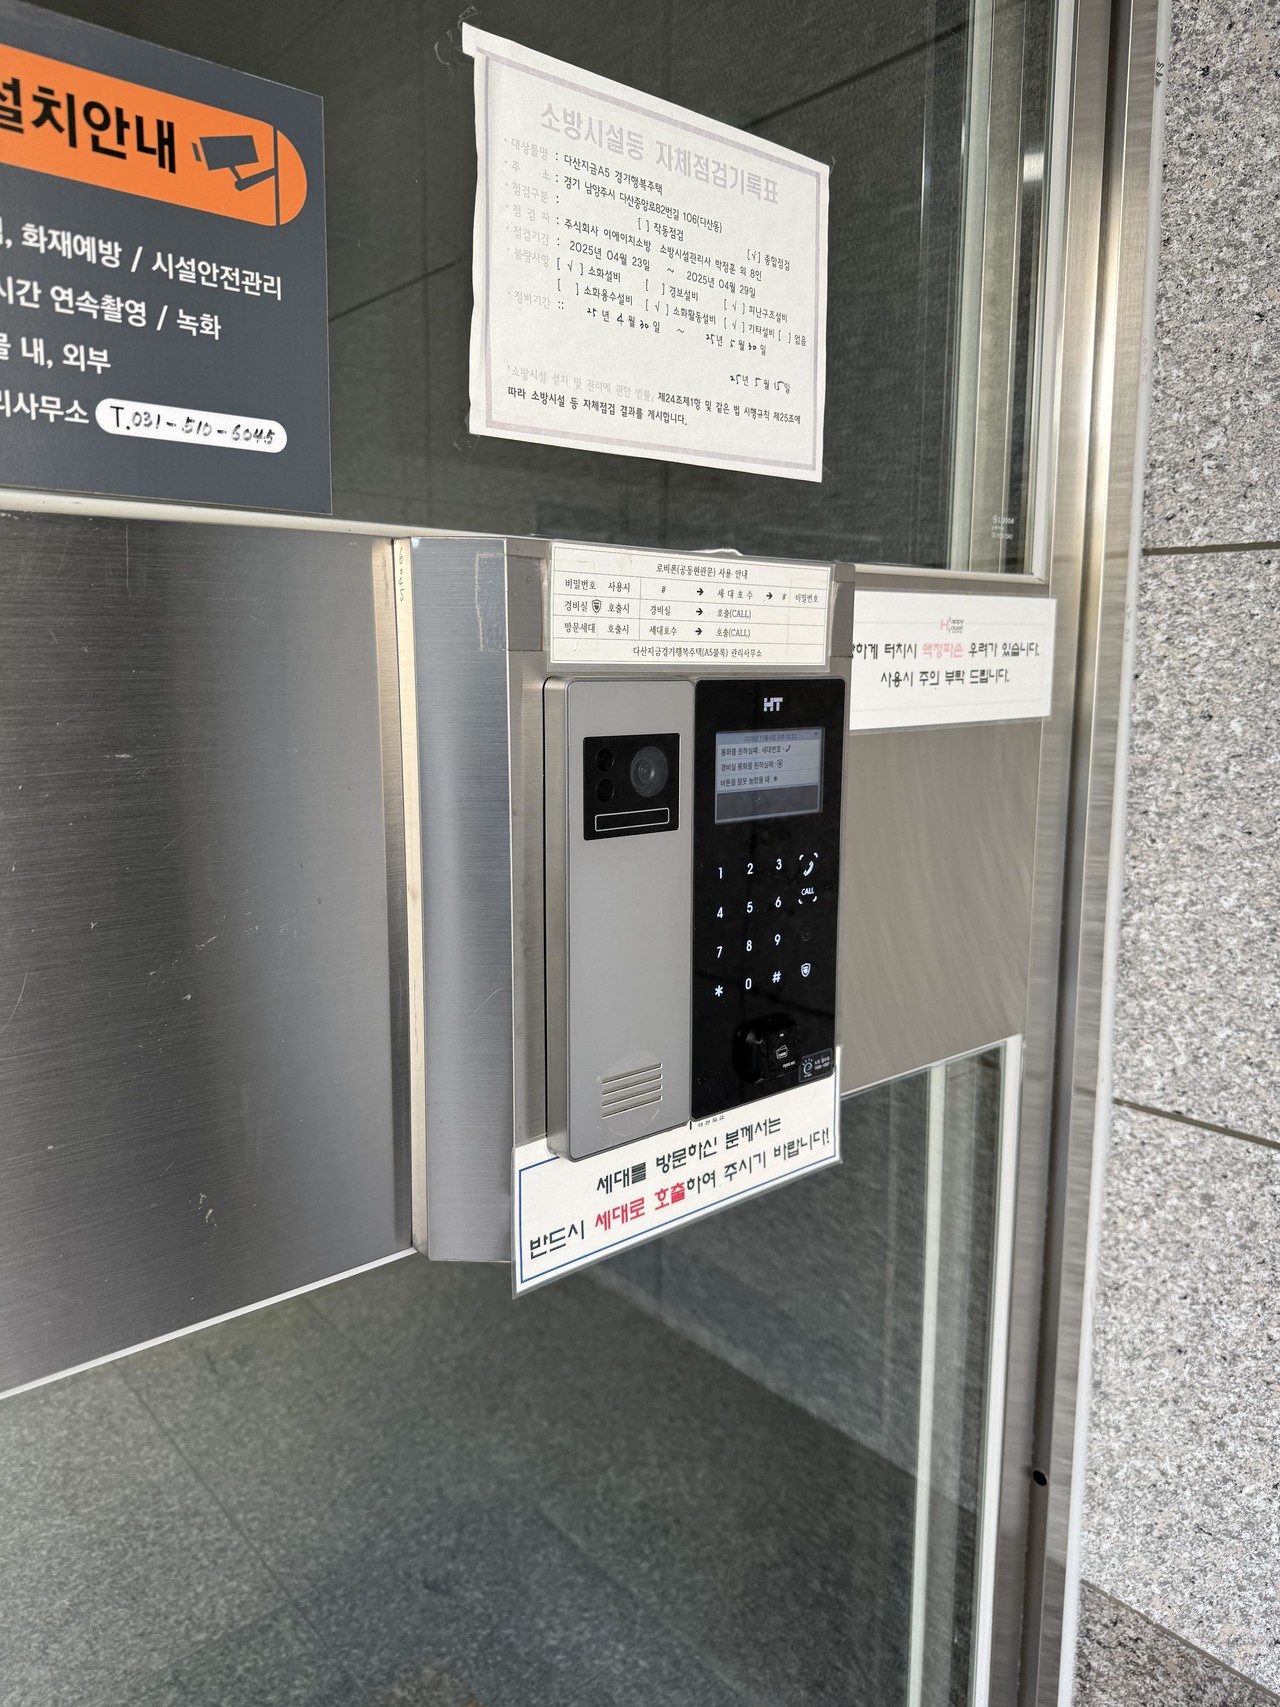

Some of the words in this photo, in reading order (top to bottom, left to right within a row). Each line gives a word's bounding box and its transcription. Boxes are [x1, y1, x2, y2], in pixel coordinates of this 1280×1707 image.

[541, 103, 645, 161] 소방시설등
[656, 140, 779, 204] 자체점검기록표
[511, 137, 548, 161] 대상물명
[564, 154, 610, 178] 다산지금A5
[615, 170, 663, 196] 경기행복주택
[512, 182, 549, 204] 점검구분
[564, 175, 581, 190] 경기
[584, 181, 616, 200] 남양주시
[619, 192, 680, 221] 다산중앙로82번길
[683, 212, 723, 234] 106(다산동)
[564, 218, 599, 237] 주식회사
[603, 228, 652, 253] 이에이치소방
[660, 244, 712, 267] 소방시설관리사
[715, 259, 736, 275] 박정훈
[740, 266, 747, 277] 외
[750, 269, 762, 282] 8인
[653, 222, 684, 242] 작동점검
[764, 254, 791, 272] 종합점검
[22, 223, 122, 269] 화재예방
[151, 251, 282, 300] 시설안전관리
[513, 225, 550, 245] 점검기간
[570, 241, 602, 260] 2025년
[607, 250, 628, 266] 04월
[632, 256, 651, 272] 23일
[687, 271, 715, 288] 2025년
[718, 279, 736, 294] 04월
[739, 284, 756, 299] 29일
[514, 247, 550, 268] 불량사항
[588, 266, 622, 283] 소화설비
[669, 285, 699, 302] 경보설비
[748, 305, 788, 323] 피난구조설비
[514, 290, 551, 310] 정비기간
[50, 285, 147, 328] 연속촬영
[176, 311, 222, 341] 녹화
[584, 285, 634, 306] 소화용수설비
[673, 305, 717, 325] 소화활동설비
[748, 324, 775, 339] 기타설비
[794, 334, 807, 347] 없음
[21, 337, 53, 369] 내,
[62, 343, 112, 375] 외부
[508, 386, 526, 400] 따라
[531, 390, 565, 408] 소방시설
[569, 397, 579, 410] 등
[583, 399, 616, 416] 자체점검
[620, 405, 643, 420] 결과를
[647, 409, 688, 427] 게시합니다.
[551, 372, 569, 386] 설치
[586, 378, 611, 394] 관리에
[615, 383, 632, 399] 관한
[658, 391, 701, 411] 제24조제1항
[705, 400, 712, 412] 및
[716, 401, 730, 415] 같은
[733, 404, 740, 416] 법
[744, 405, 770, 421] 시행규칙
[773, 410, 801, 425] 제25조에
[656, 563, 716, 578] 로비폰(공동현관문)
[718, 569, 732, 579] 사용
[735, 570, 748, 580] 안내
[565, 579, 597, 591] 비밀번호
[607, 582, 631, 593] 사용시
[795, 593, 819, 603] 비밀번호
[564, 600, 588, 612] 경비실
[607, 602, 630, 614] 호출시
[649, 605, 671, 616] 경비실
[716, 609, 752, 619] 호출(CALL)
[564, 622, 596, 634] 방문세대
[607, 624, 630, 635] 호출시
[649, 625, 678, 637] 세대호수
[715, 628, 751, 638] 호출(CALL)
[632, 646, 729, 658] 다산지금경기행복주택(A5블록)
[731, 647, 762, 658] 관리사무소
[884, 642, 917, 660] 터치시
[922, 642, 964, 659] 액정파손
[968, 642, 998, 658] 우려가
[1002, 642, 1040, 657] 있습니다.
[880, 671, 914, 688] 사용시
[919, 670, 939, 687] 주의
[945, 669, 965, 685] 부탁
[970, 668, 1010, 684] 드립니다.
[763, 697, 784, 712] HT
[721, 747, 736, 756] 통화를
[761, 745, 781, 754] 세대번호
[721, 763, 736, 773] 경비실
[738, 762, 753, 771] 통화를
[718, 867, 723, 879] 1
[747, 863, 754, 875] 2
[776, 858, 782, 870] 3
[801, 887, 815, 896] CALL
[746, 901, 753, 913] 5
[775, 896, 782, 908] 6
[716, 906, 724, 918] 4
[746, 939, 753, 952] 8
[774, 934, 781, 946] 9
[716, 945, 723, 958] 7
[745, 977, 752, 990] 0
[772, 970, 782, 983] #
[596, 1161, 647, 1195] 세대를
[655, 1135, 717, 1174] 방문하신
[724, 1117, 781, 1151] 분께서는
[529, 1220, 585, 1260] 반드시
[594, 1197, 646, 1231] 세대로
[654, 1169, 716, 1211] 호출하여
[724, 1150, 767, 1182] 주시기
[773, 1127, 830, 1161] 바랍니다!
